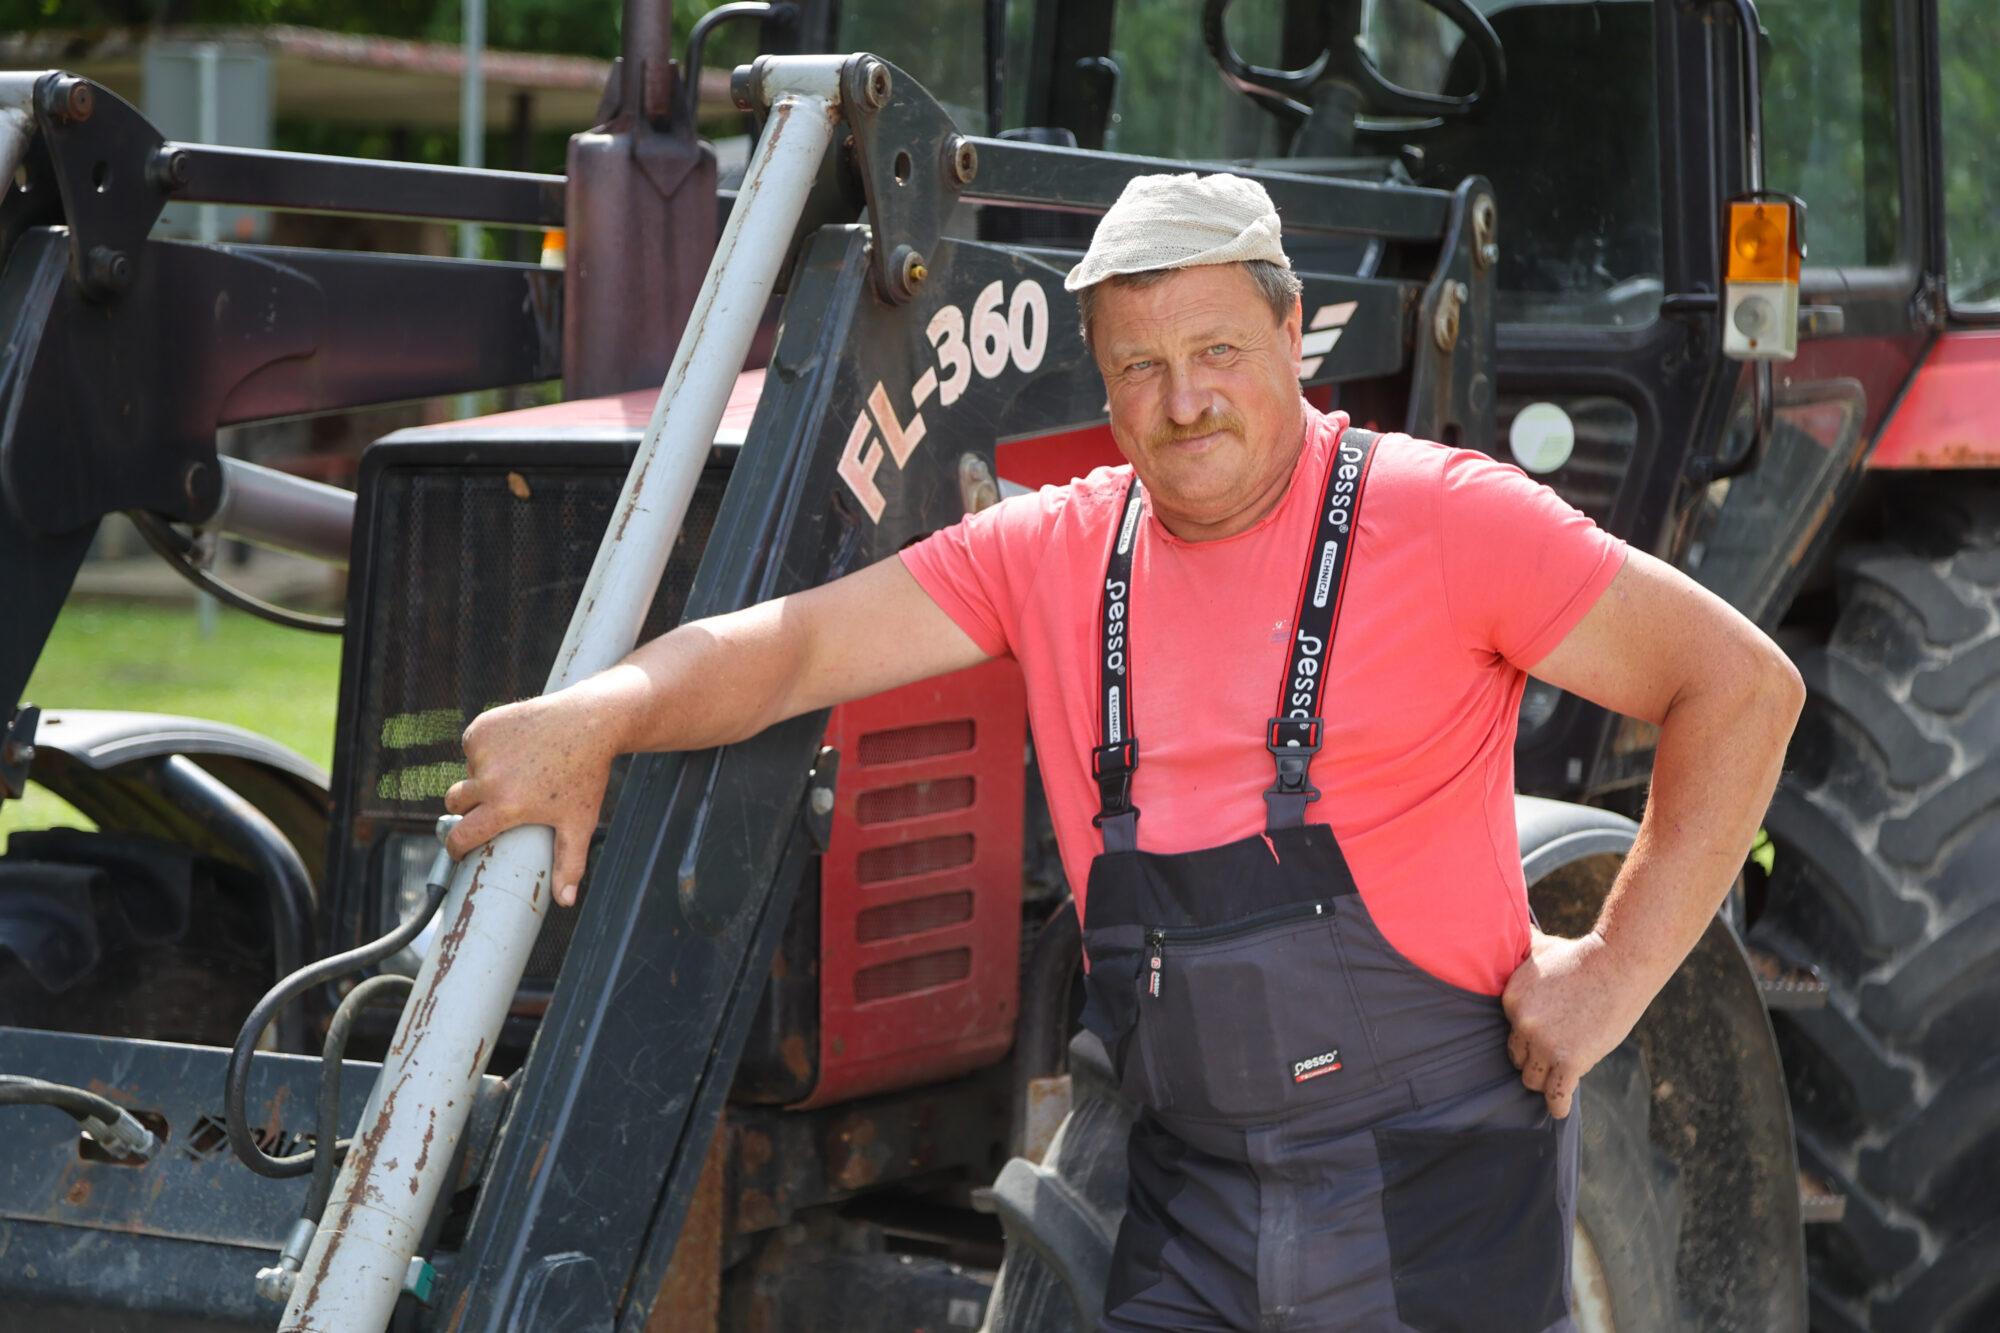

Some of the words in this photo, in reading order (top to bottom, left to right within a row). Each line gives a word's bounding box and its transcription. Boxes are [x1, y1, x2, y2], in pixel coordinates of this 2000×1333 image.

[837, 279, 1049, 525] FL-360
[1316, 547, 1334, 601] TECHNICAL
[1111, 693, 1119, 744] TECHNICA
[1294, 1053, 1334, 1077] pesso
